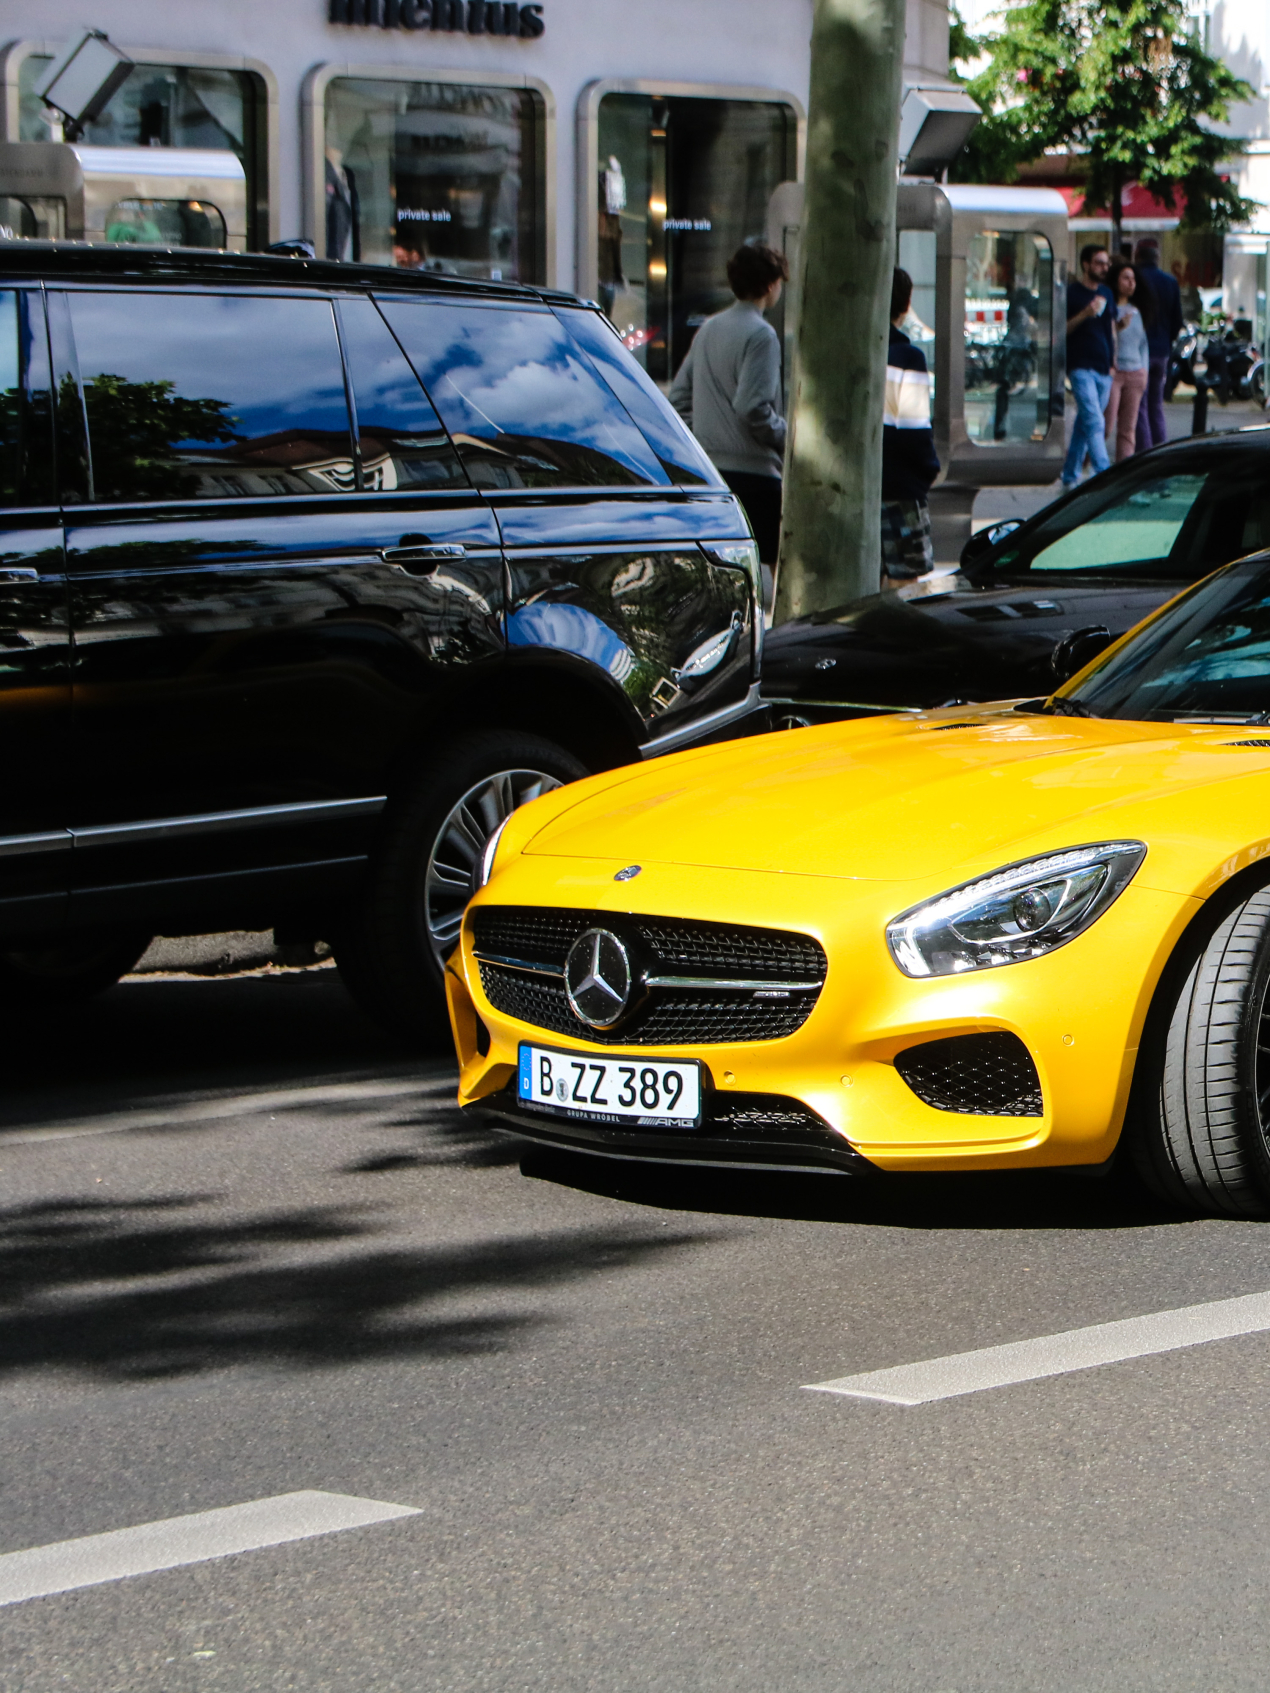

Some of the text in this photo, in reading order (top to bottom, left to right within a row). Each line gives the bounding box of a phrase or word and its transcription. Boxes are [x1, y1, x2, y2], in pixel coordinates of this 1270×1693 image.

[397, 207, 452, 222] private sale
[663, 218, 712, 232] private sale
[523, 1077, 530, 1090] D
[540, 1055, 683, 1110] B ZZ 389
[566, 1109, 588, 1119] GRUPA
[655, 1118, 694, 1128] AMG
